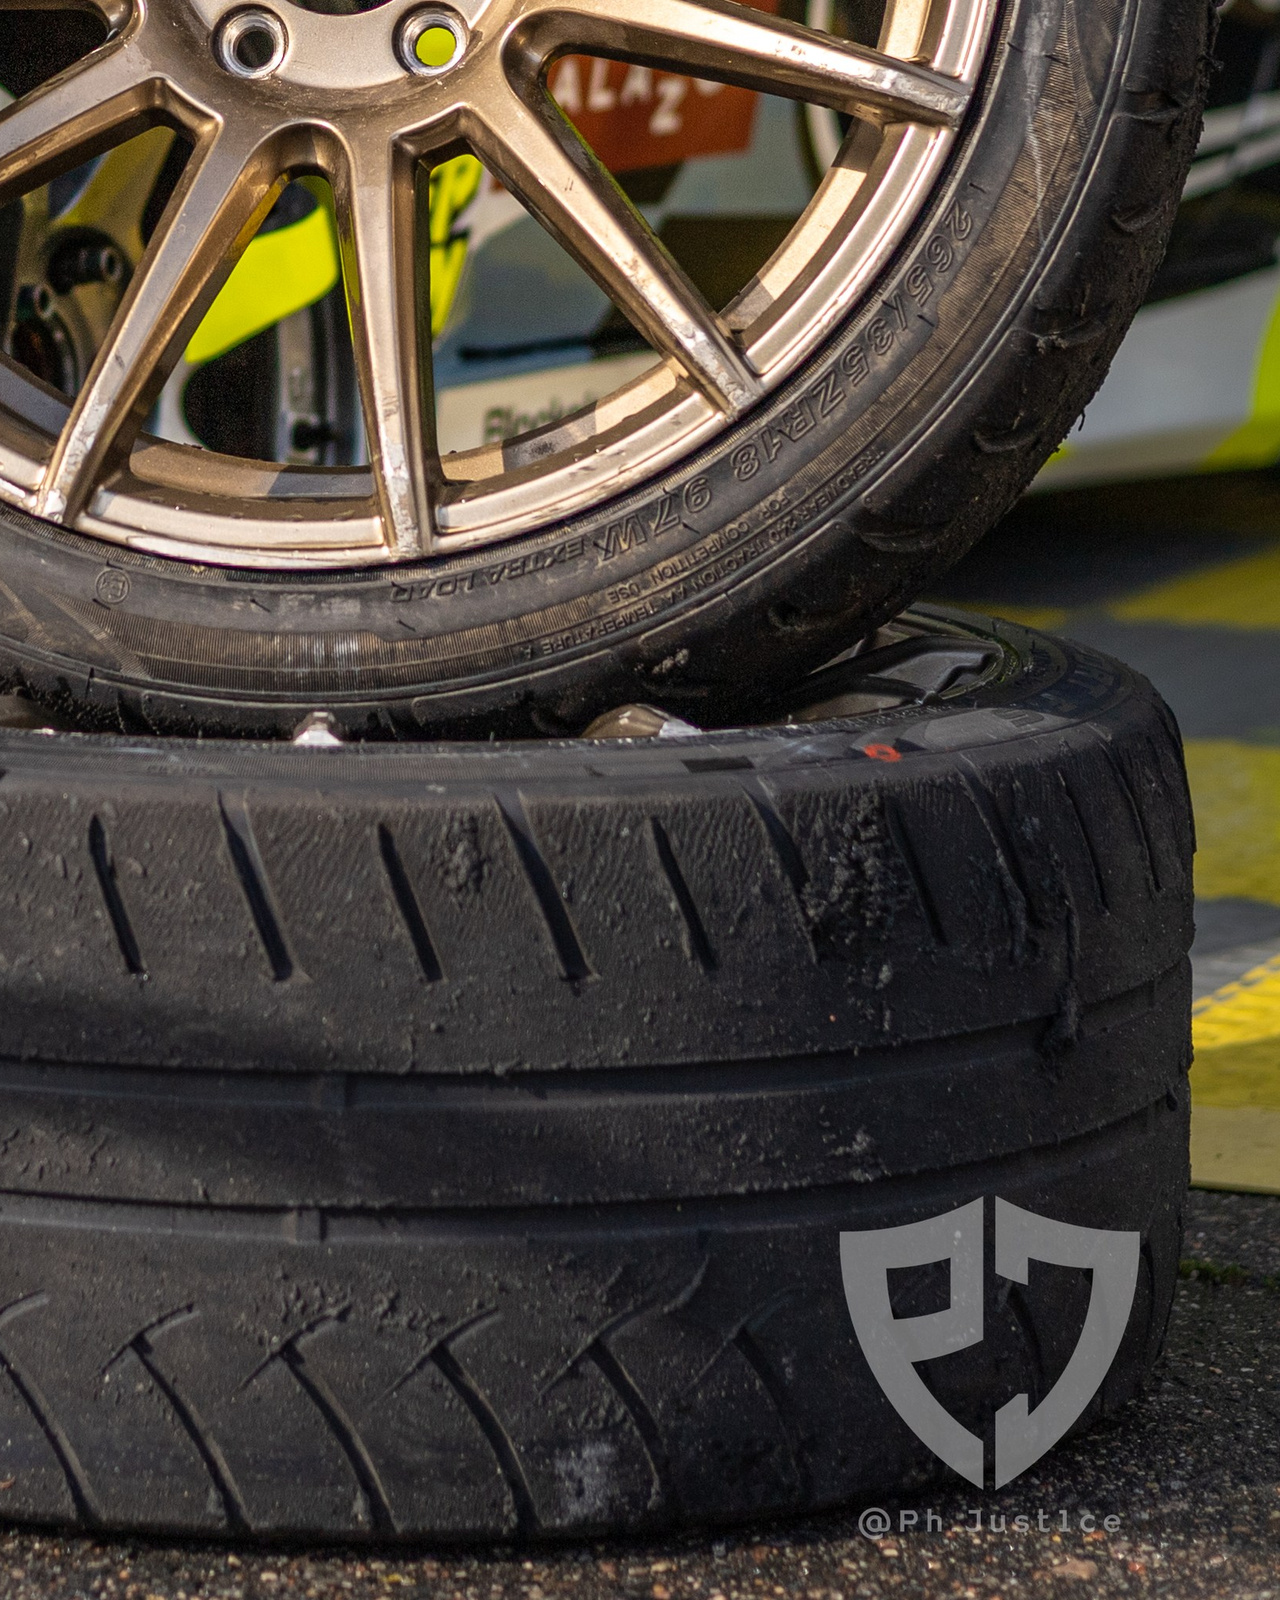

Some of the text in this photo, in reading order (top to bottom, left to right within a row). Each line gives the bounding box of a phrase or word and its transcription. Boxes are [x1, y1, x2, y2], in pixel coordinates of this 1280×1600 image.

[587, 195, 981, 564] 265/35ZR18 97W
[791, 441, 886, 525] TREADWEAR
[387, 536, 589, 605] EXTRA LOAD
[605, 490, 793, 606] FOR COMPETITION USE
[688, 534, 770, 593] TRACTION
[538, 597, 659, 656] TEMPERATURE
[658, 582, 690, 610] AA
